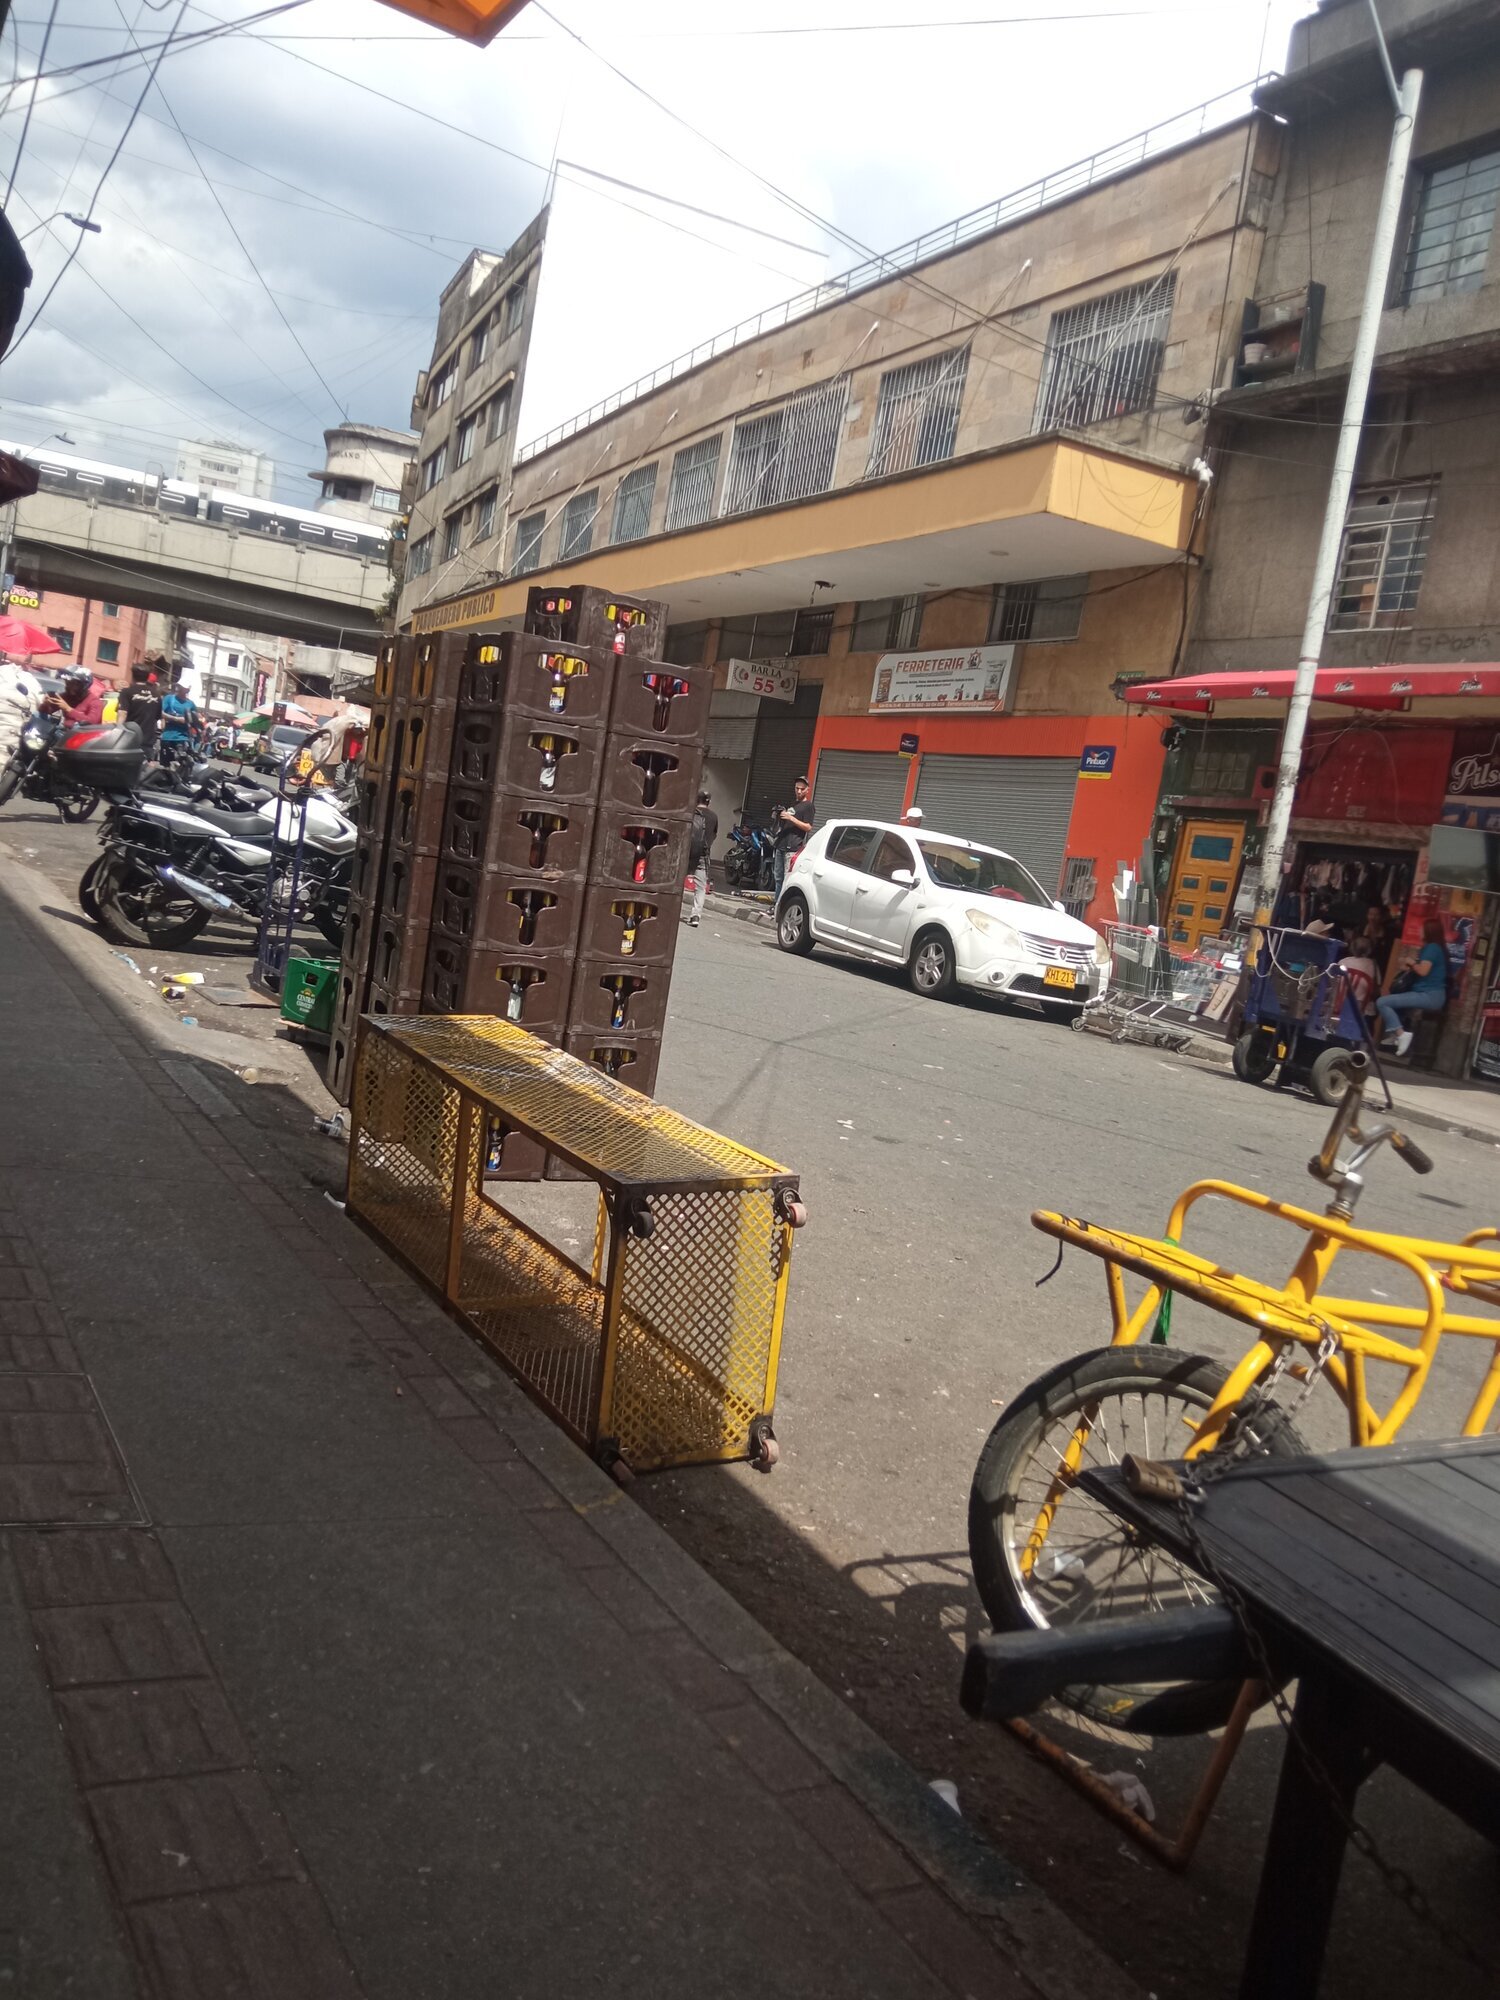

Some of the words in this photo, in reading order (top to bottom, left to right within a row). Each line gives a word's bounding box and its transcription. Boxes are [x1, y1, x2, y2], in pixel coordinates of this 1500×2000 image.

[415, 603, 462, 632] PARQUEADERO
[462, 592, 496, 620] PUBLICO
[751, 665, 769, 676] BAR
[771, 669, 782, 678] LA
[896, 657, 965, 673] FERRETERIA
[753, 676, 774, 693] 55
[1086, 757, 1107, 765] Pintuco
[1449, 756, 1500, 794] Pils
